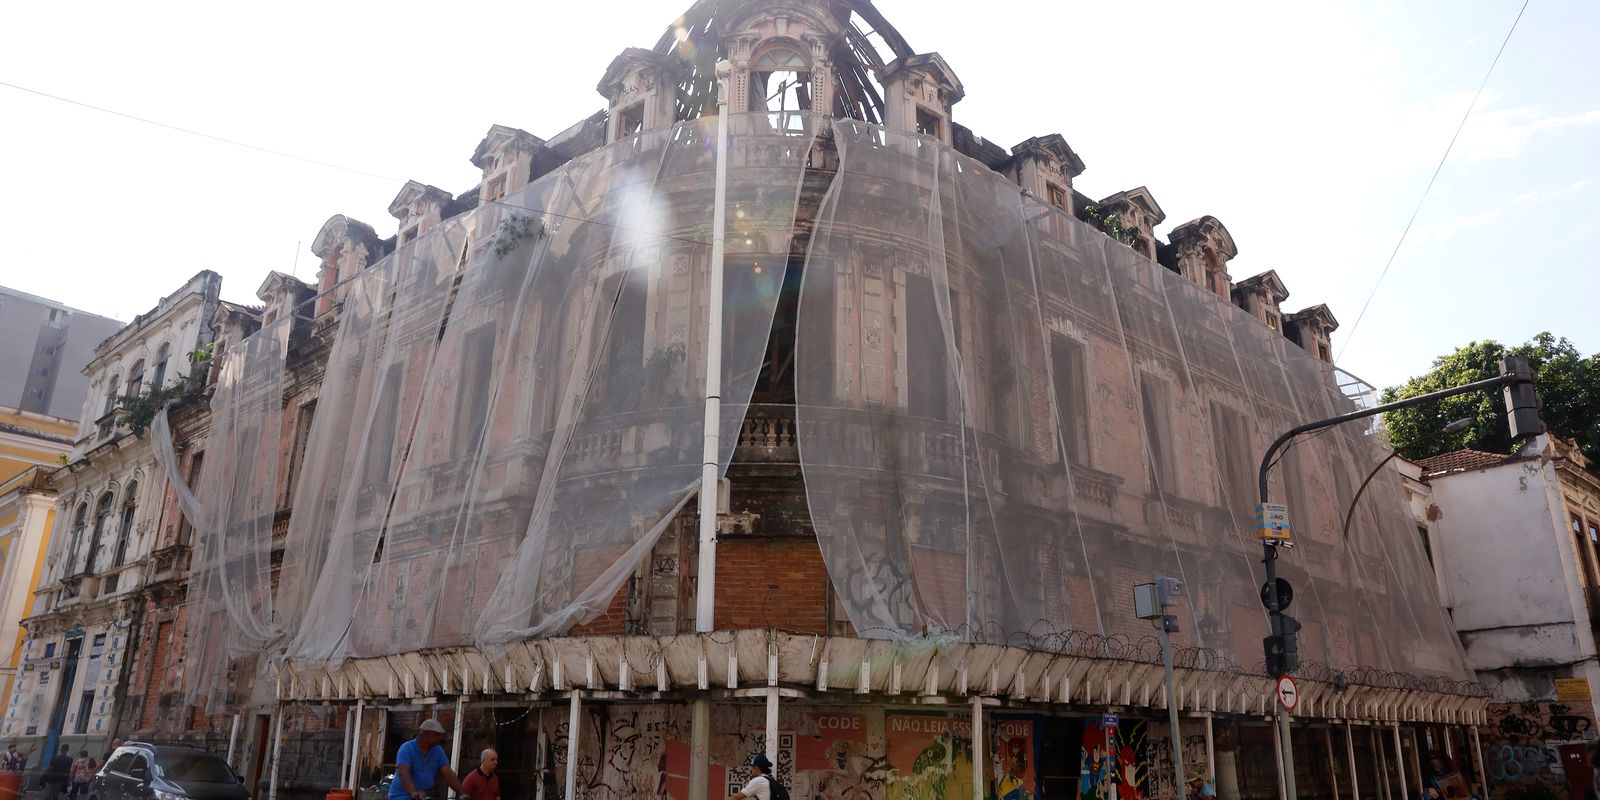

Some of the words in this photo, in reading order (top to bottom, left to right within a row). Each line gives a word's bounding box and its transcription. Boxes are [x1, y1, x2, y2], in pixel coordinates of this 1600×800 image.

[818, 716, 860, 730] CODE
[924, 719, 949, 733] LEIA
[1000, 723, 1029, 736] ODE
